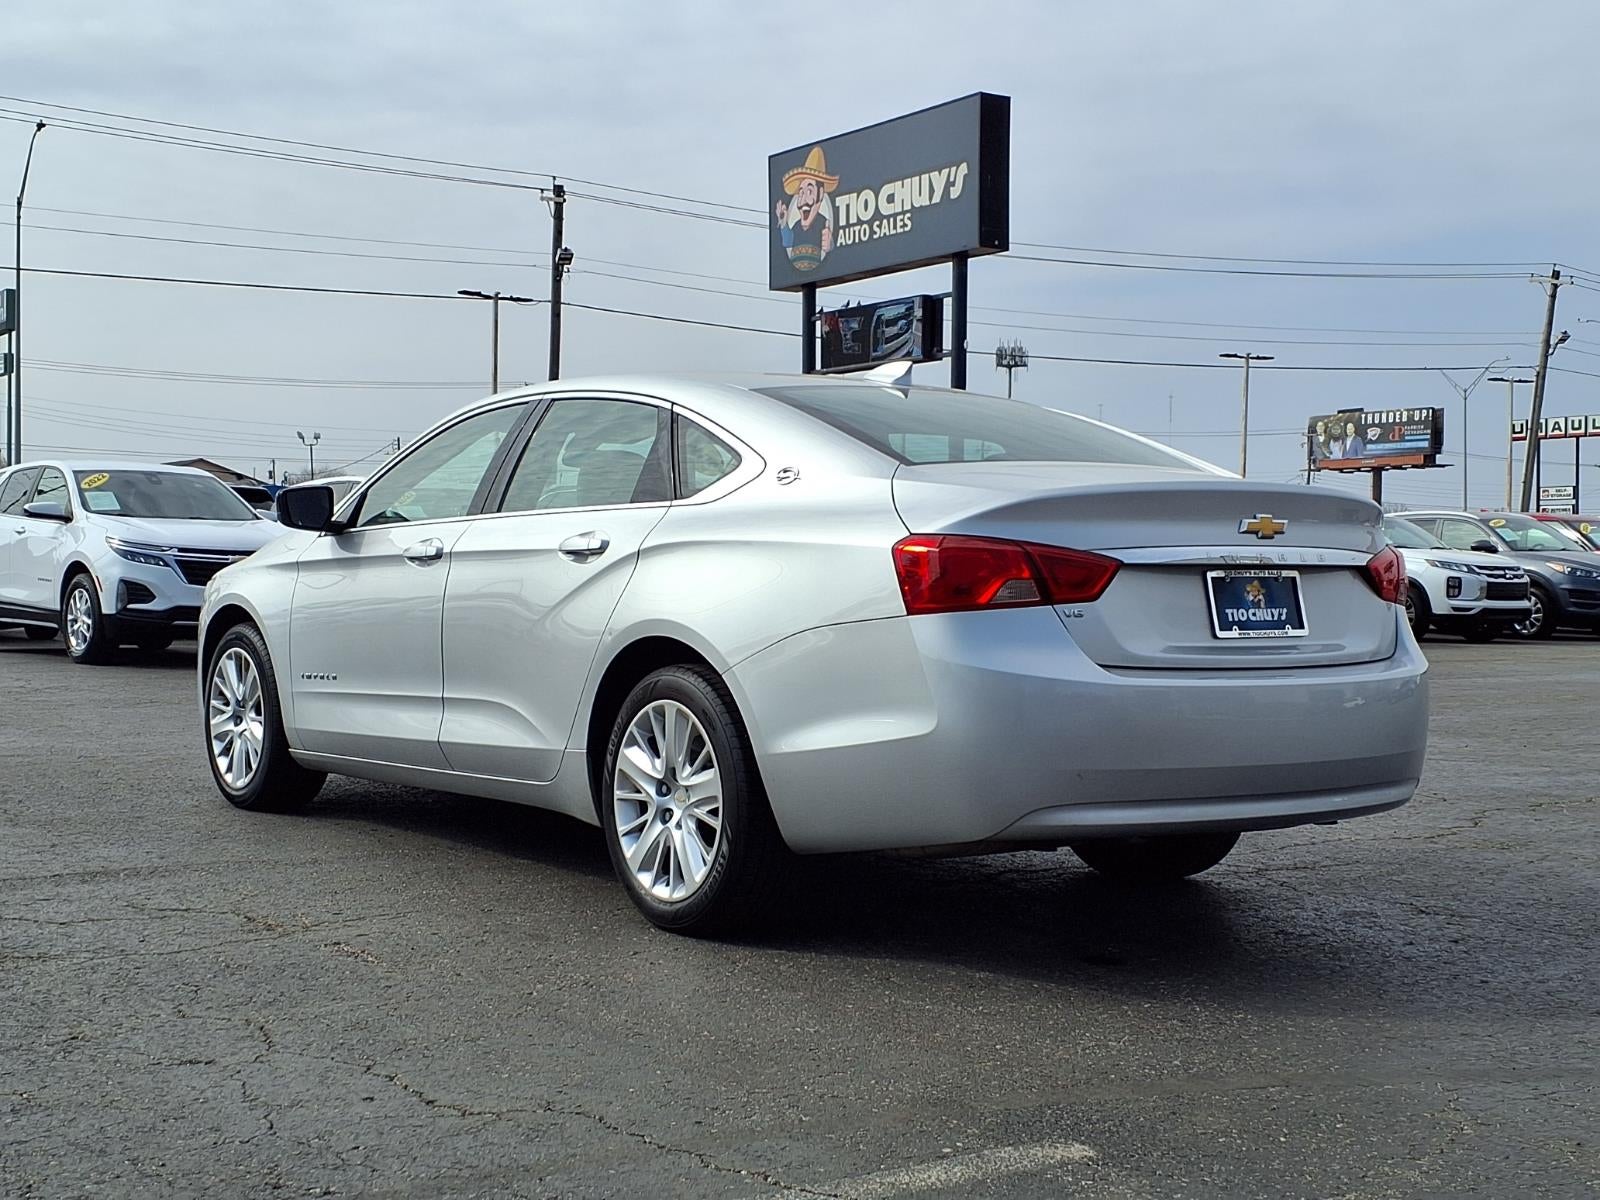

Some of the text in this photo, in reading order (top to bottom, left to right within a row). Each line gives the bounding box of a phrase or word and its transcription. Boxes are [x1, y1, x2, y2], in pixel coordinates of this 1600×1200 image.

[835, 162, 968, 226] TIO CHUY'S
[836, 213, 912, 247] AUTO SALES
[1361, 409, 1432, 424] THUNDER UP!
[1063, 608, 1084, 618] V6
[1225, 607, 1287, 621] TIO CHUY'S
